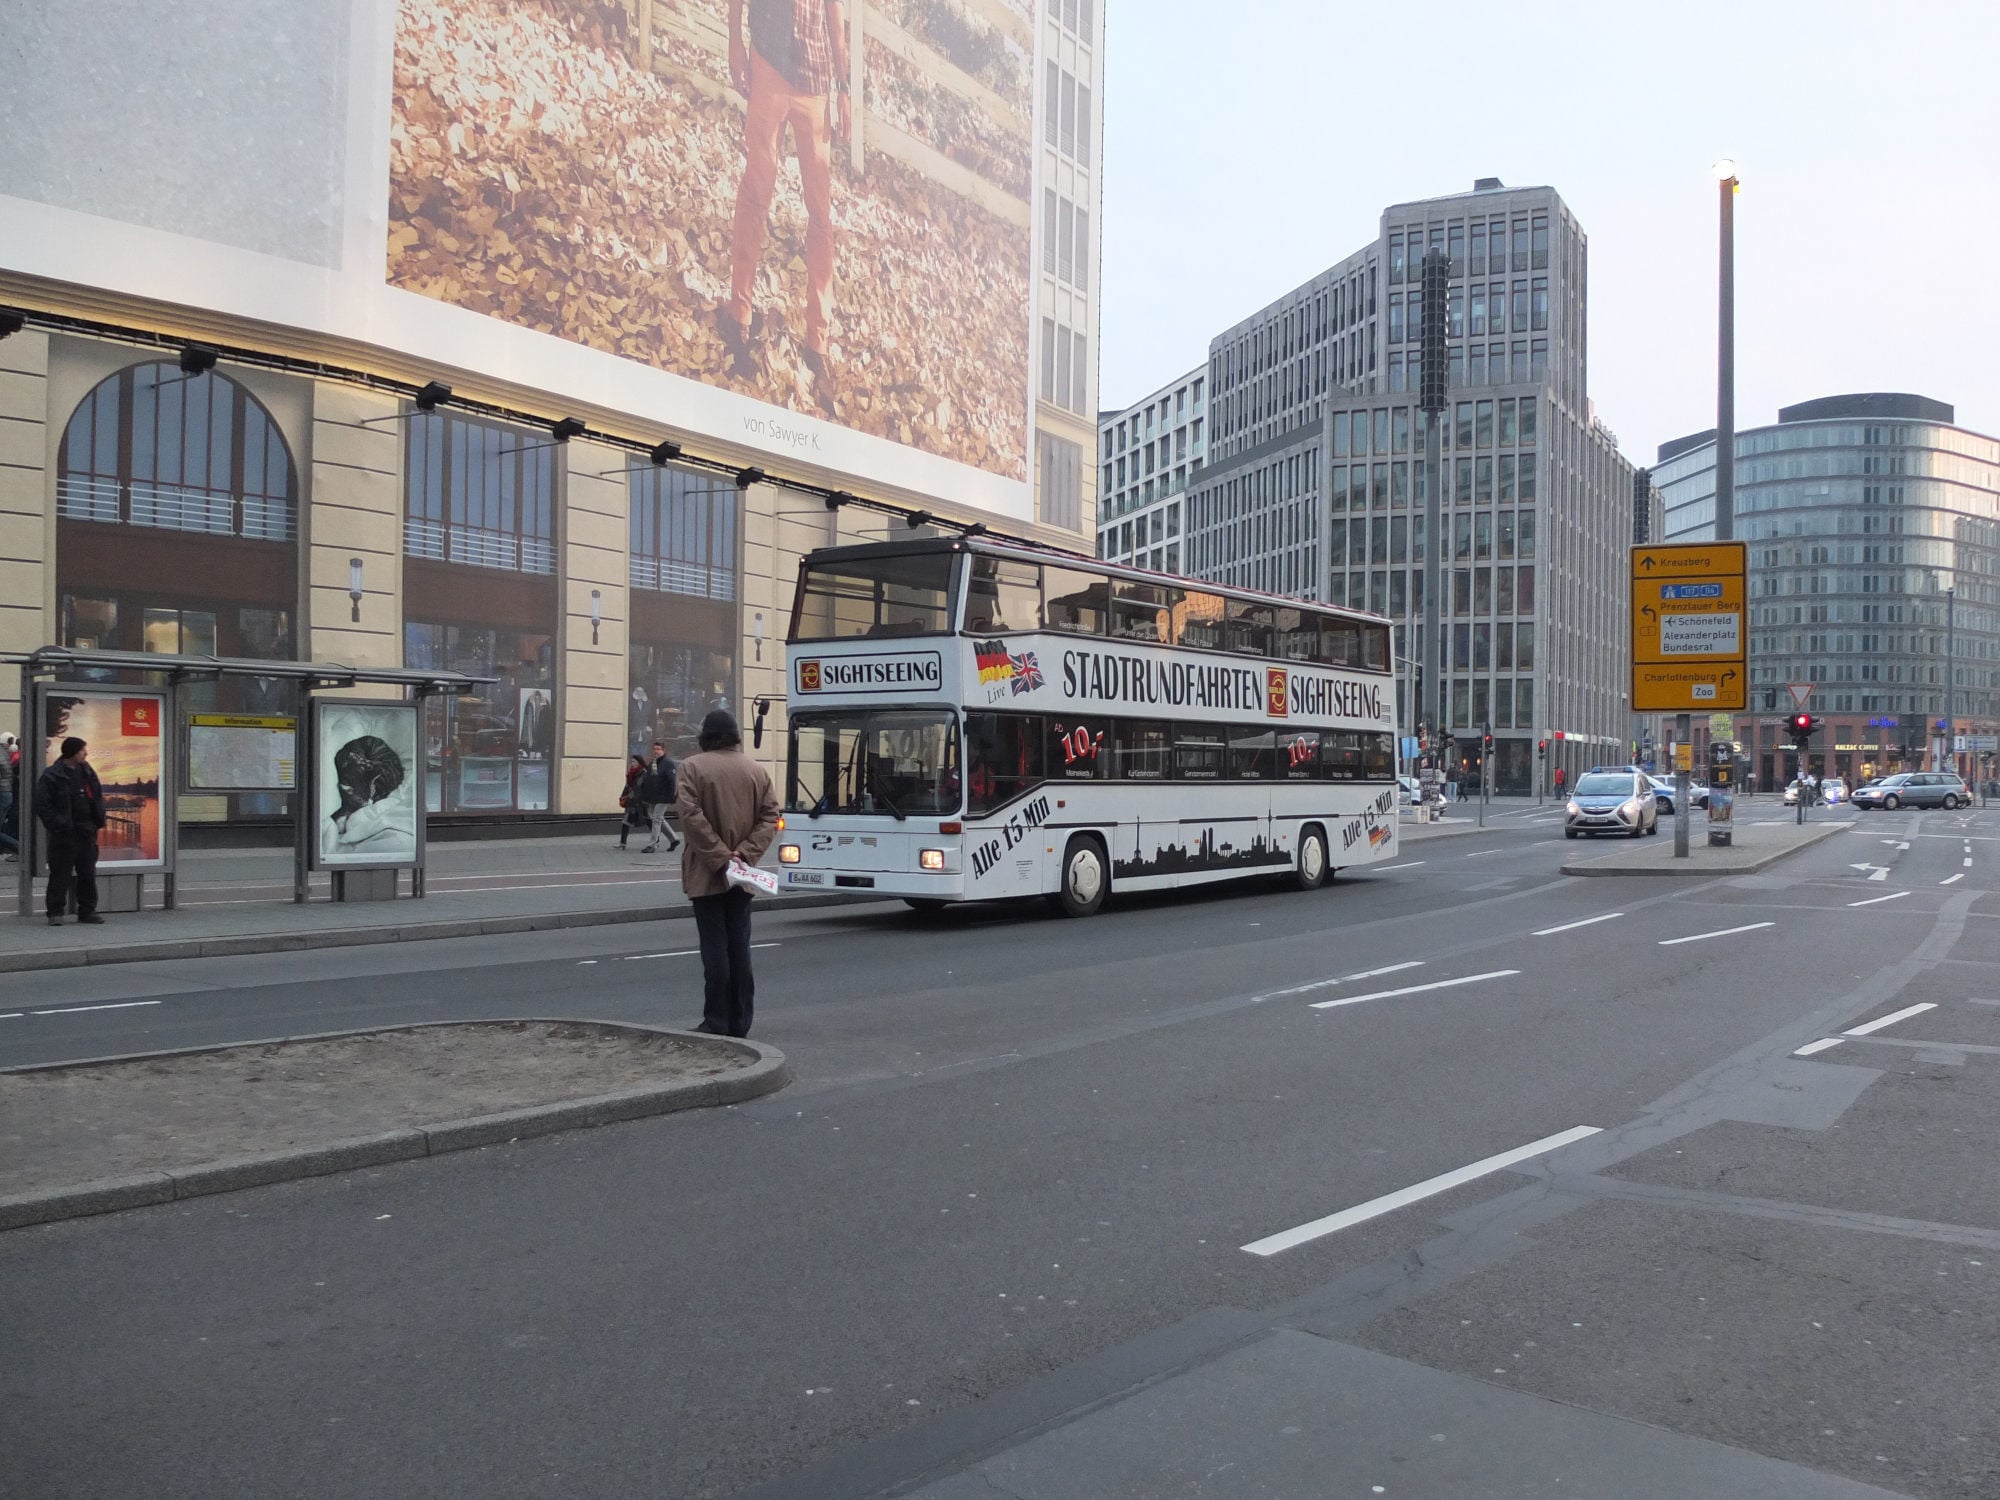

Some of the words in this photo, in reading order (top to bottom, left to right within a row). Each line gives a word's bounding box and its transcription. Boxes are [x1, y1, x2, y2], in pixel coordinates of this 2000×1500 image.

[743, 416, 765, 435] von
[769, 420, 808, 447] Sawyer
[1660, 557, 1711, 567] Kreuzberg
[1660, 602, 1713, 611] Prenzlauer
[1717, 601, 1740, 611] Berg
[1678, 616, 1732, 626] Schönefeld
[1664, 631, 1736, 641] Alexanderplatz
[1663, 643, 1713, 652] Bundesrat
[824, 661, 938, 685] SIGHTSEEING
[1644, 673, 1717, 682] Charlottenburg
[1063, 650, 1262, 711] STADTRUNDFAHRTEN
[987, 685, 1006, 704] Live
[1291, 675, 1381, 720] SIGHTSEEING
[1695, 688, 1713, 697] Zoo
[1343, 819, 1362, 851] Alle
[1362, 804, 1375, 830] 15
[1375, 790, 1393, 818] Min
[971, 837, 1001, 880] Alle
[1003, 814, 1023, 851] 15
[1024, 795, 1051, 833] Min
